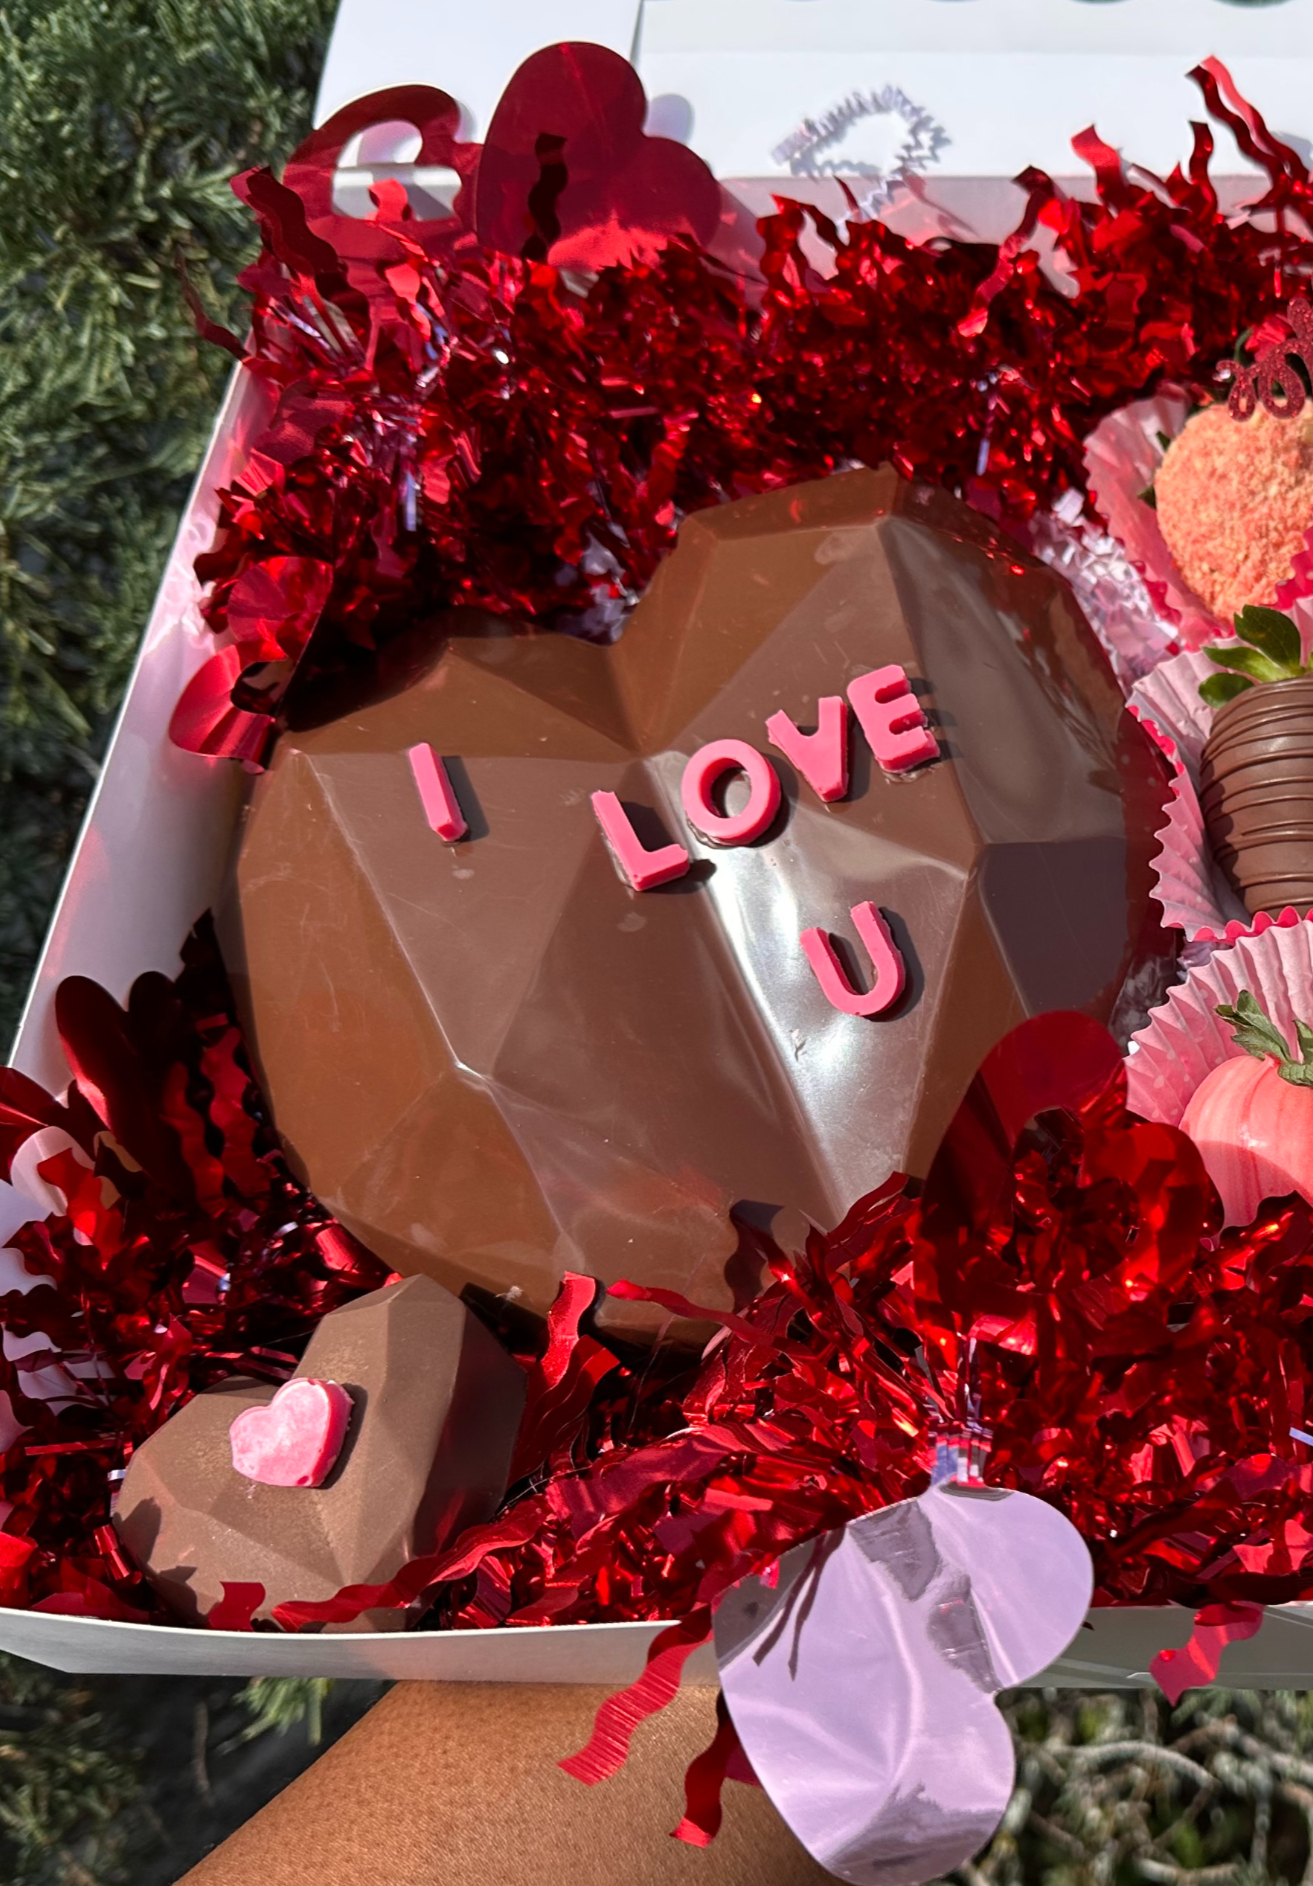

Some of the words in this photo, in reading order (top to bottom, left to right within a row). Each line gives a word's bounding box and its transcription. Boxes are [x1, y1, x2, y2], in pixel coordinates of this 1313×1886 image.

[408, 742, 468, 842] I
[591, 664, 941, 892] LOVE
[801, 900, 906, 1018] U
